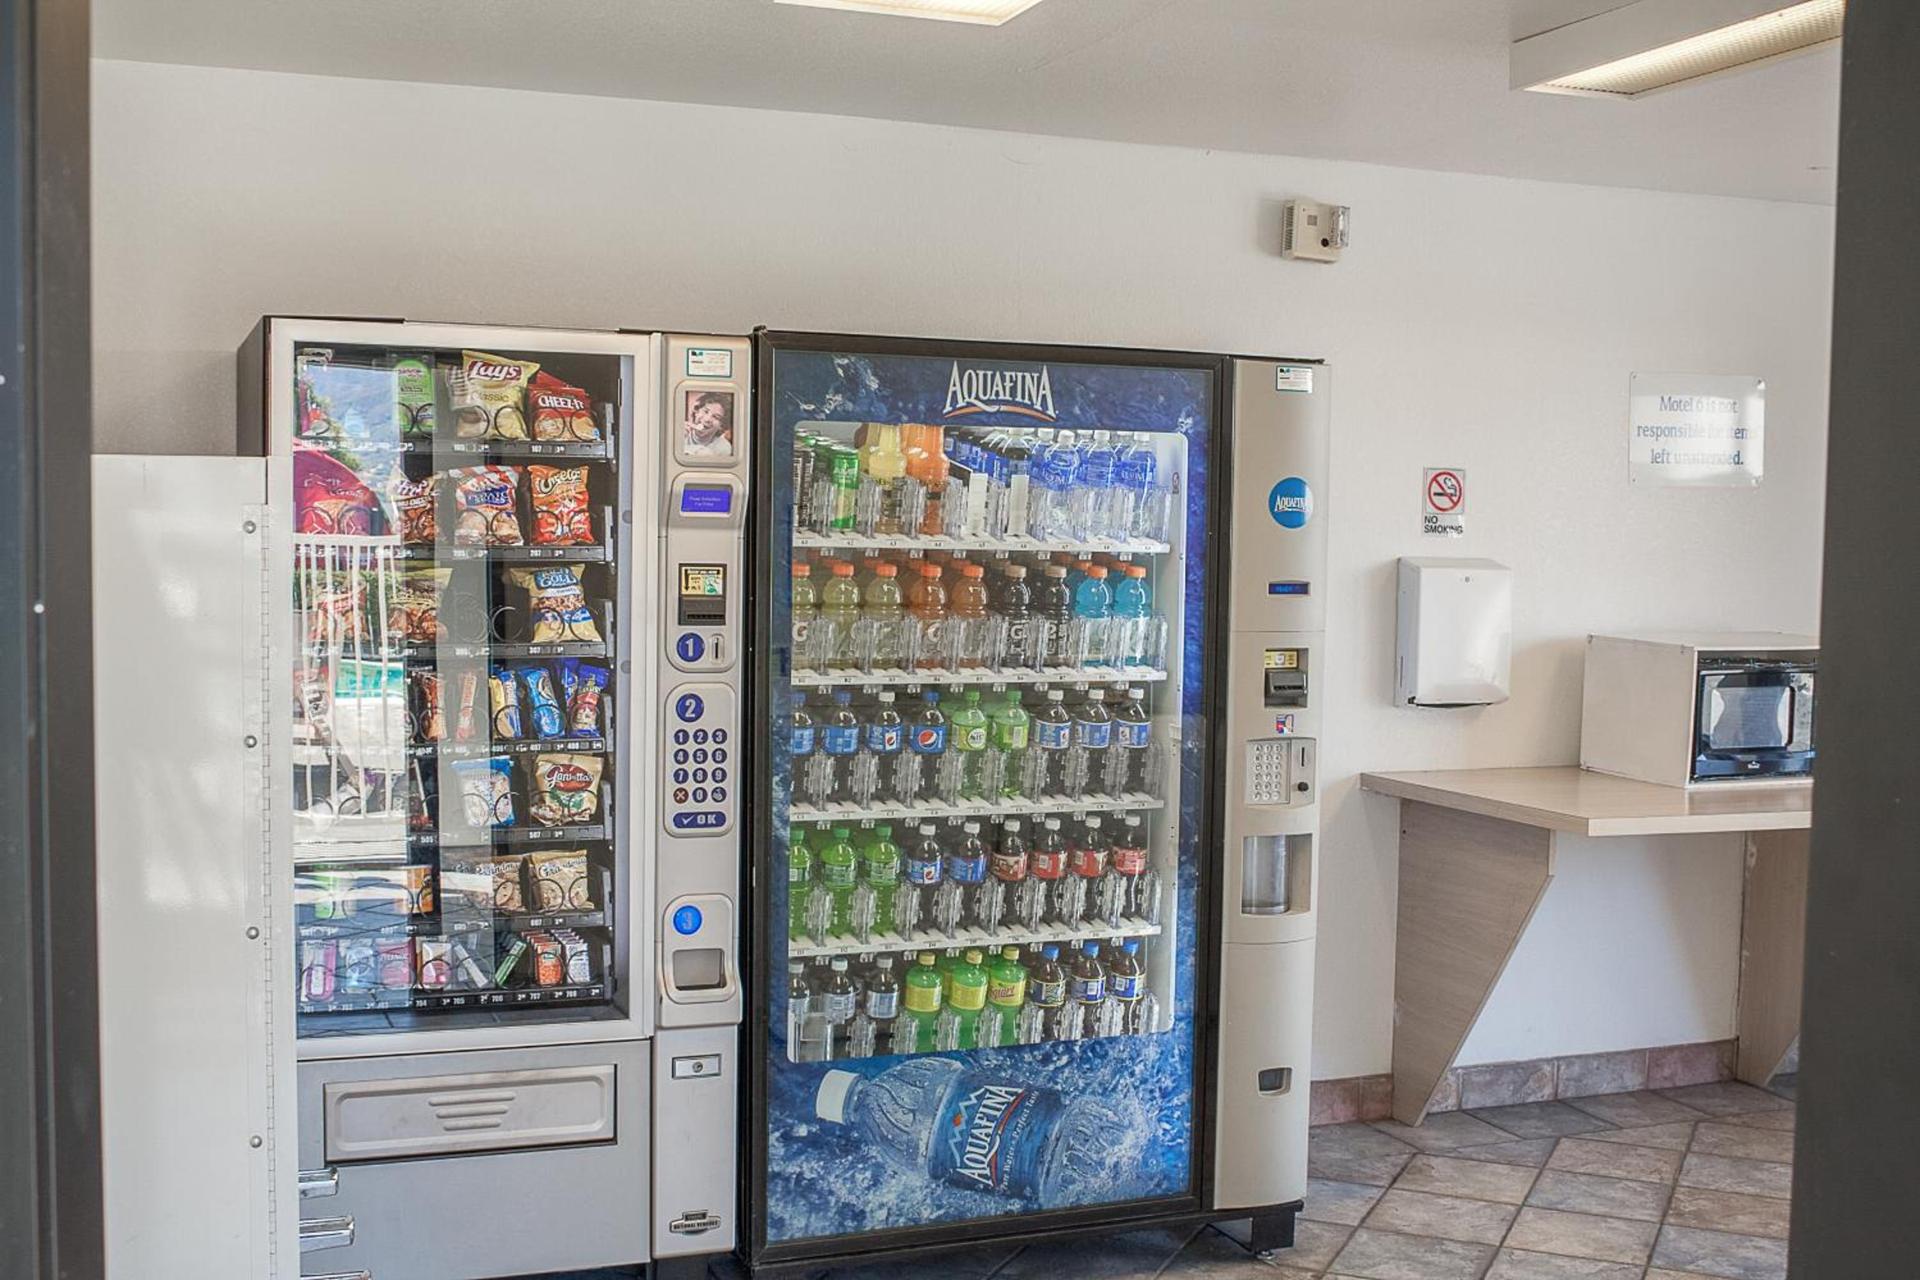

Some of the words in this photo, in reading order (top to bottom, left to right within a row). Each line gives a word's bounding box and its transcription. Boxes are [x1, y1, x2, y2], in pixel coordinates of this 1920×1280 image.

[943, 360, 1056, 418] AQUAFINA
[1659, 396, 1693, 412] Motel
[1636, 424, 1705, 441] responsib
[1650, 448, 1671, 464] left
[1424, 515, 1438, 524] NO
[685, 638, 694, 657] 1
[685, 698, 696, 718] 2
[677, 732, 684, 742] 1
[696, 732, 704, 742] 2
[715, 732, 723, 742] 3
[677, 751, 684, 761] 4
[696, 751, 704, 761] 5
[715, 751, 723, 761] 6
[677, 770, 684, 780] 7
[696, 770, 704, 780] 8
[715, 770, 723, 780] 9
[696, 789, 704, 800] 0
[697, 813, 717, 824] OK
[956, 1084, 1025, 1187] AQUAFINA
